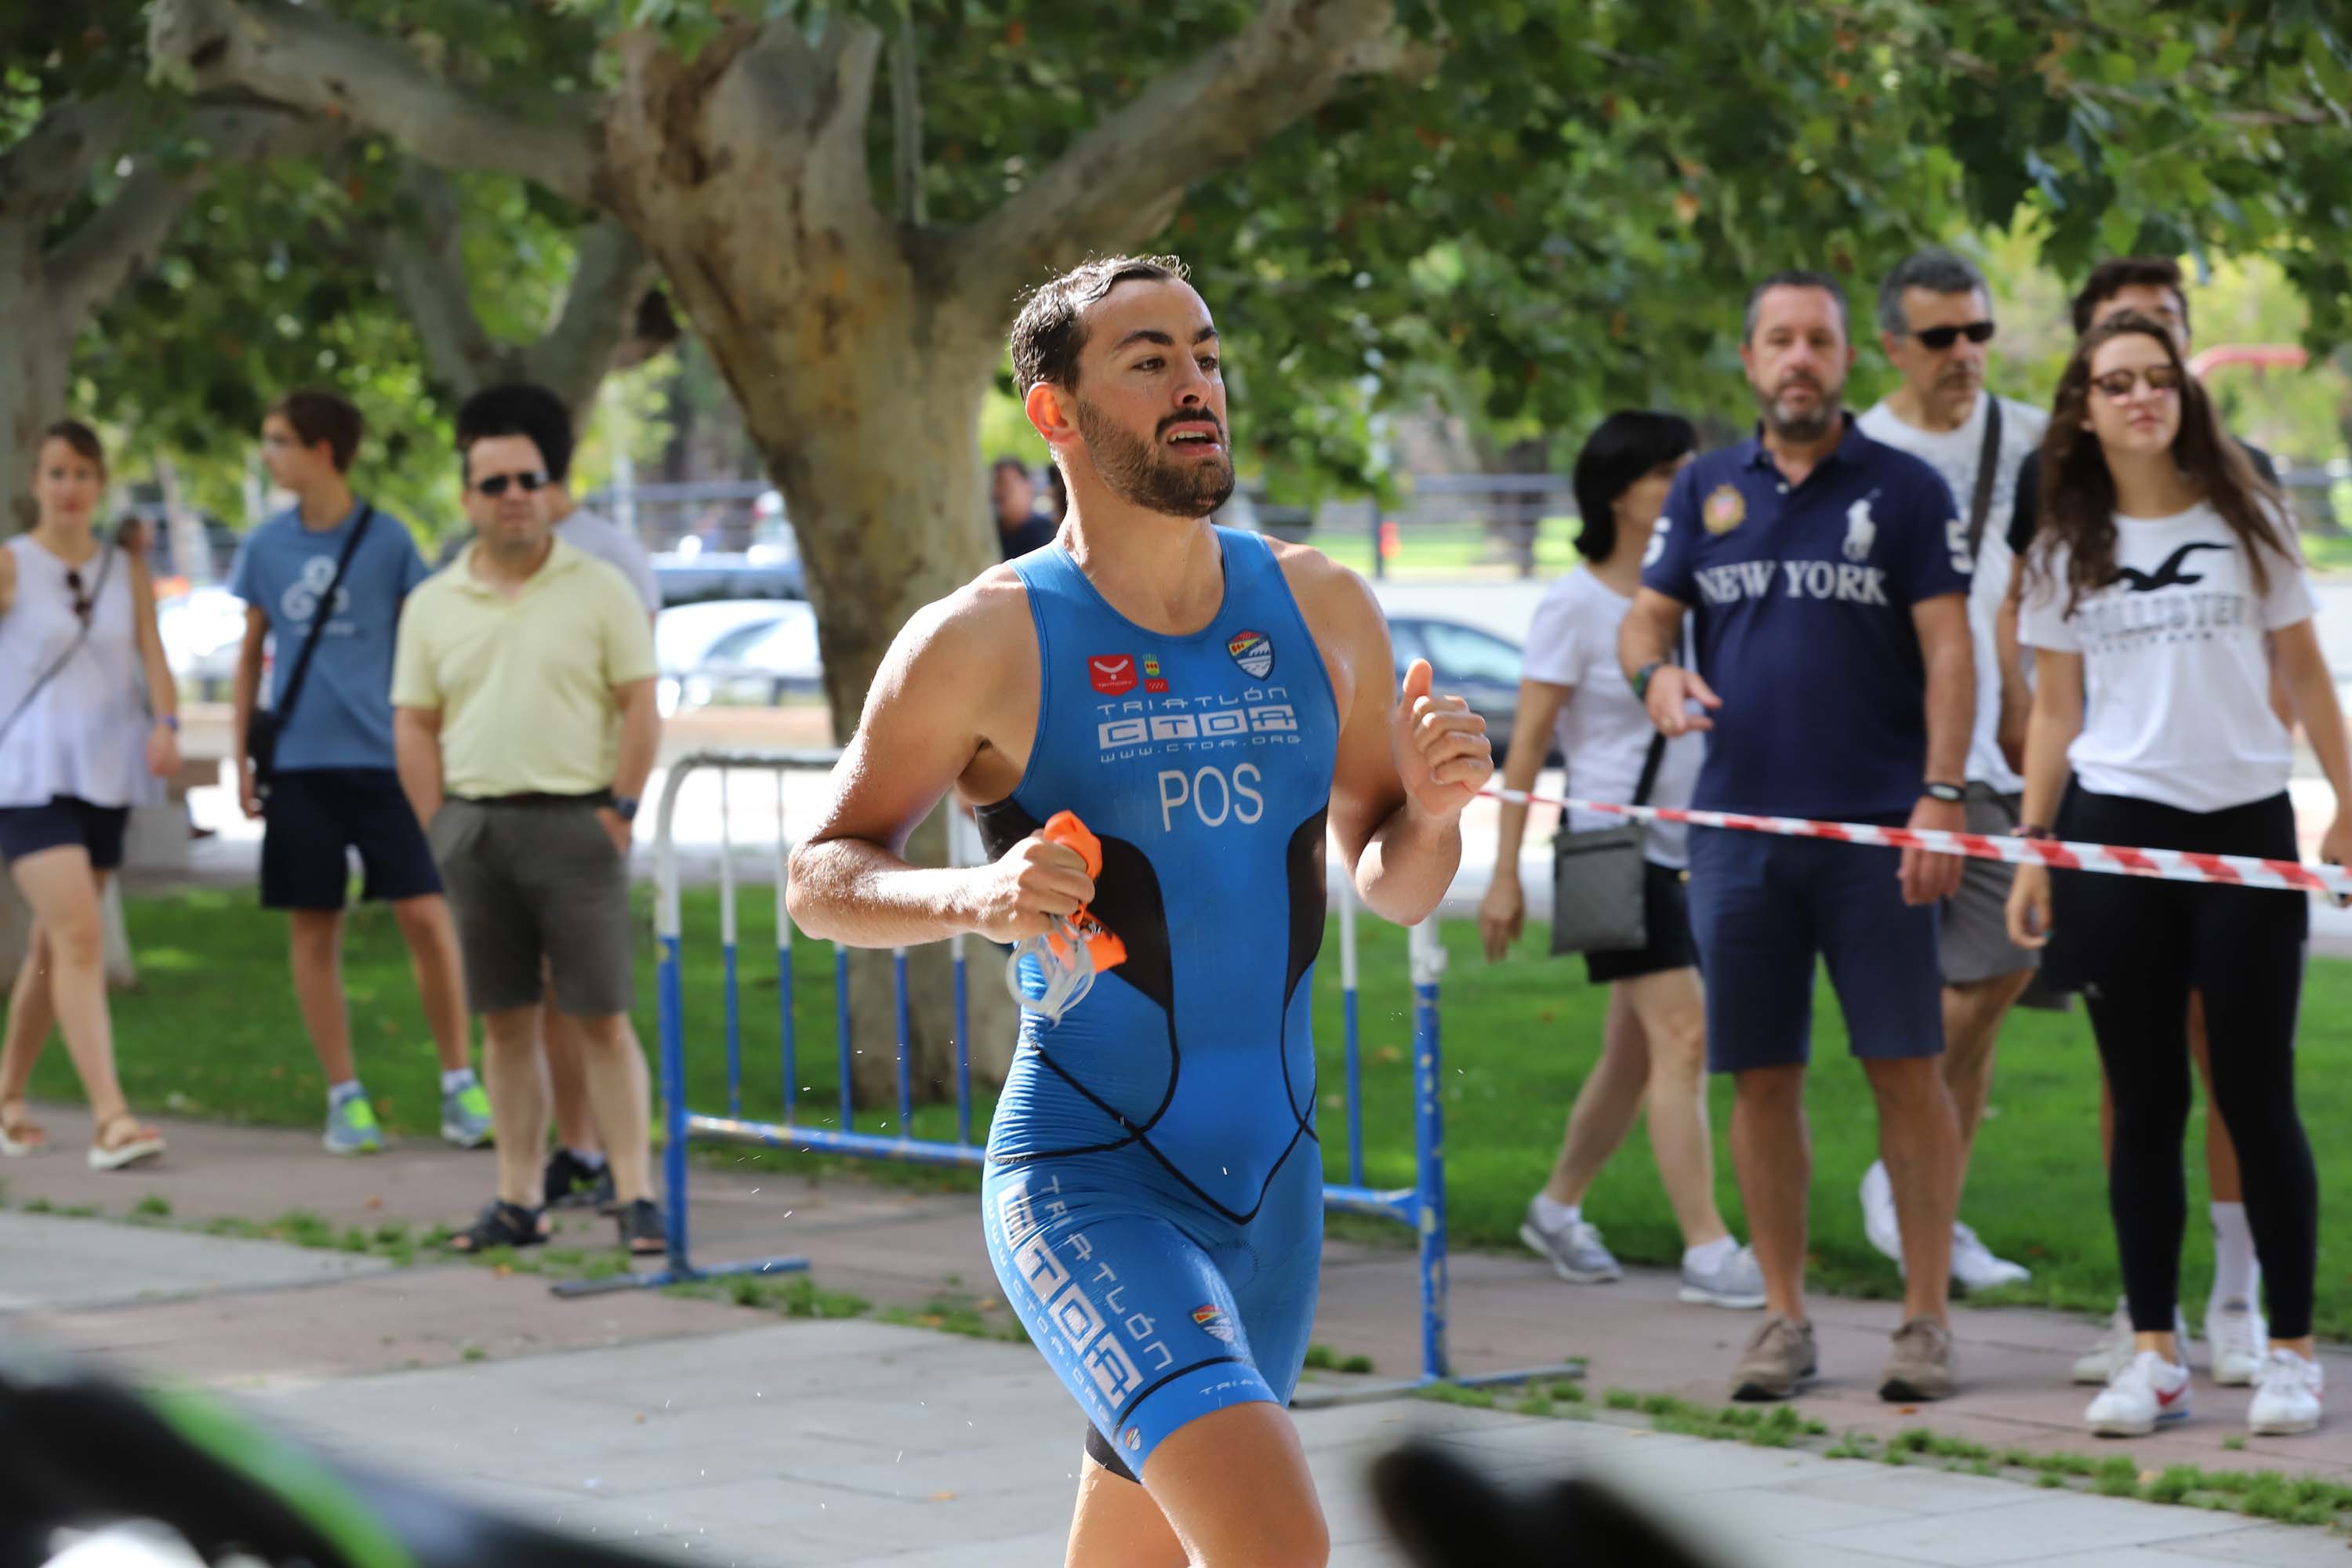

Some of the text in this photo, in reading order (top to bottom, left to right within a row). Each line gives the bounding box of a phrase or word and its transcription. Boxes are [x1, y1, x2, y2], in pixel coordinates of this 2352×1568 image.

[1694, 560, 1889, 606] NEW YORK
[1158, 762, 1264, 833] POS
